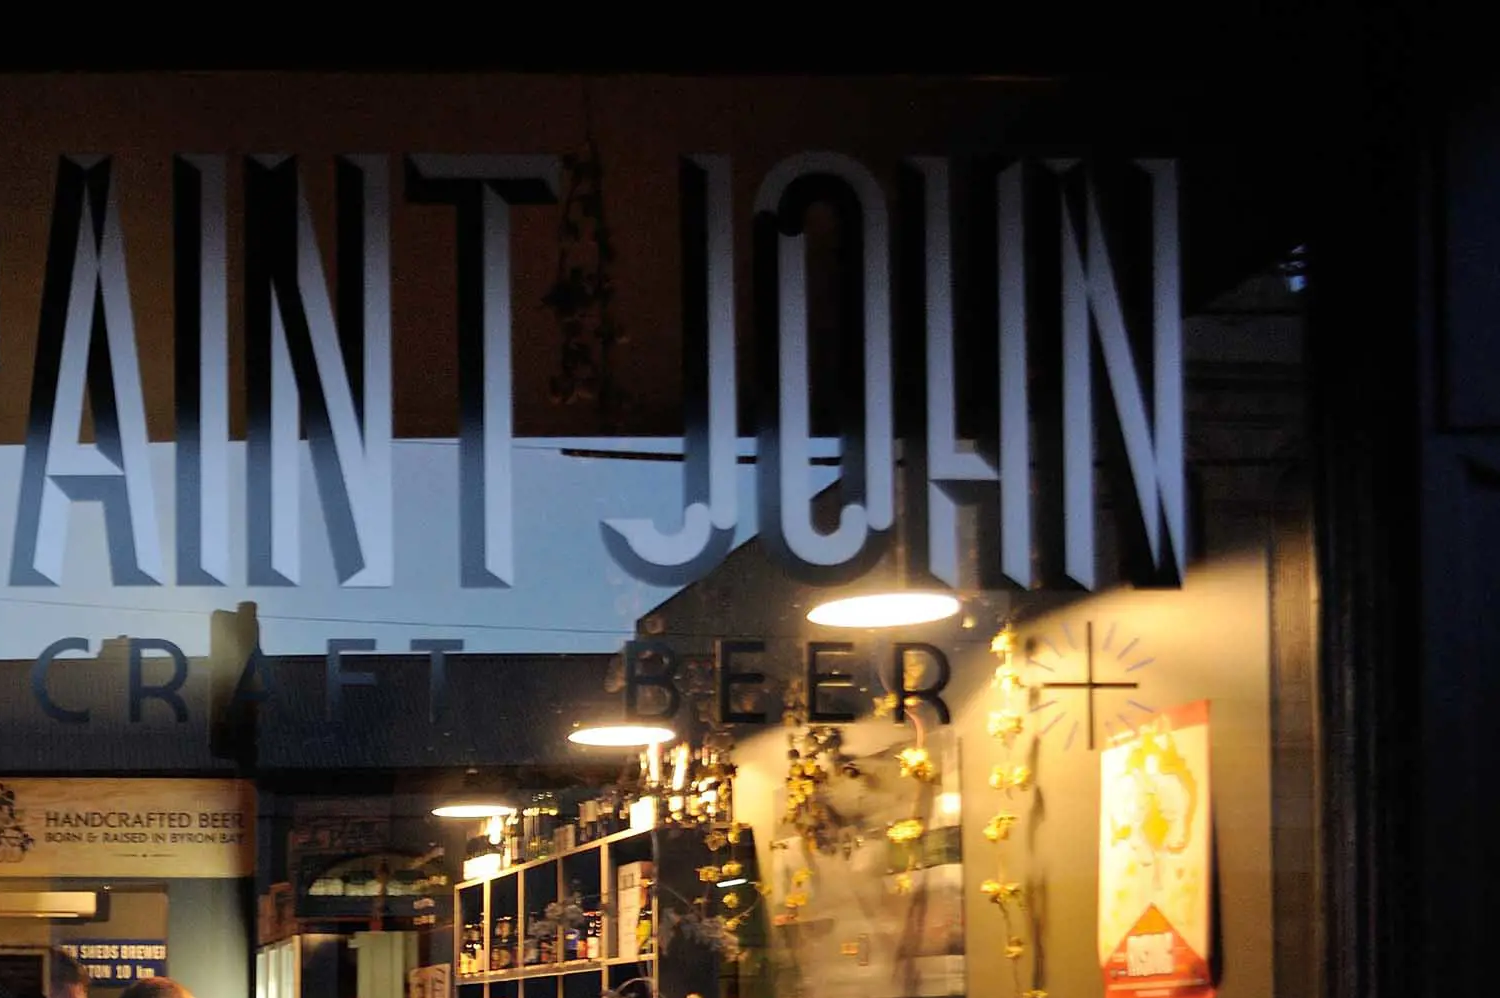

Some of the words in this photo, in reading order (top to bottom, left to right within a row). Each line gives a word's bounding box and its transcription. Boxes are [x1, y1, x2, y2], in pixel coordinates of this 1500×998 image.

[600, 150, 1190, 590] JOHN
[31, 636, 467, 724] CRAFT
[622, 640, 952, 726] BEER
[44, 811, 192, 829] HANDCRAFTED
[198, 811, 245, 829] BEER
[44, 832, 83, 844] BORN
[102, 832, 147, 844] RAISED
[151, 833, 166, 844] IN
[170, 832, 216, 844] BYRON
[220, 833, 244, 844] BAY
